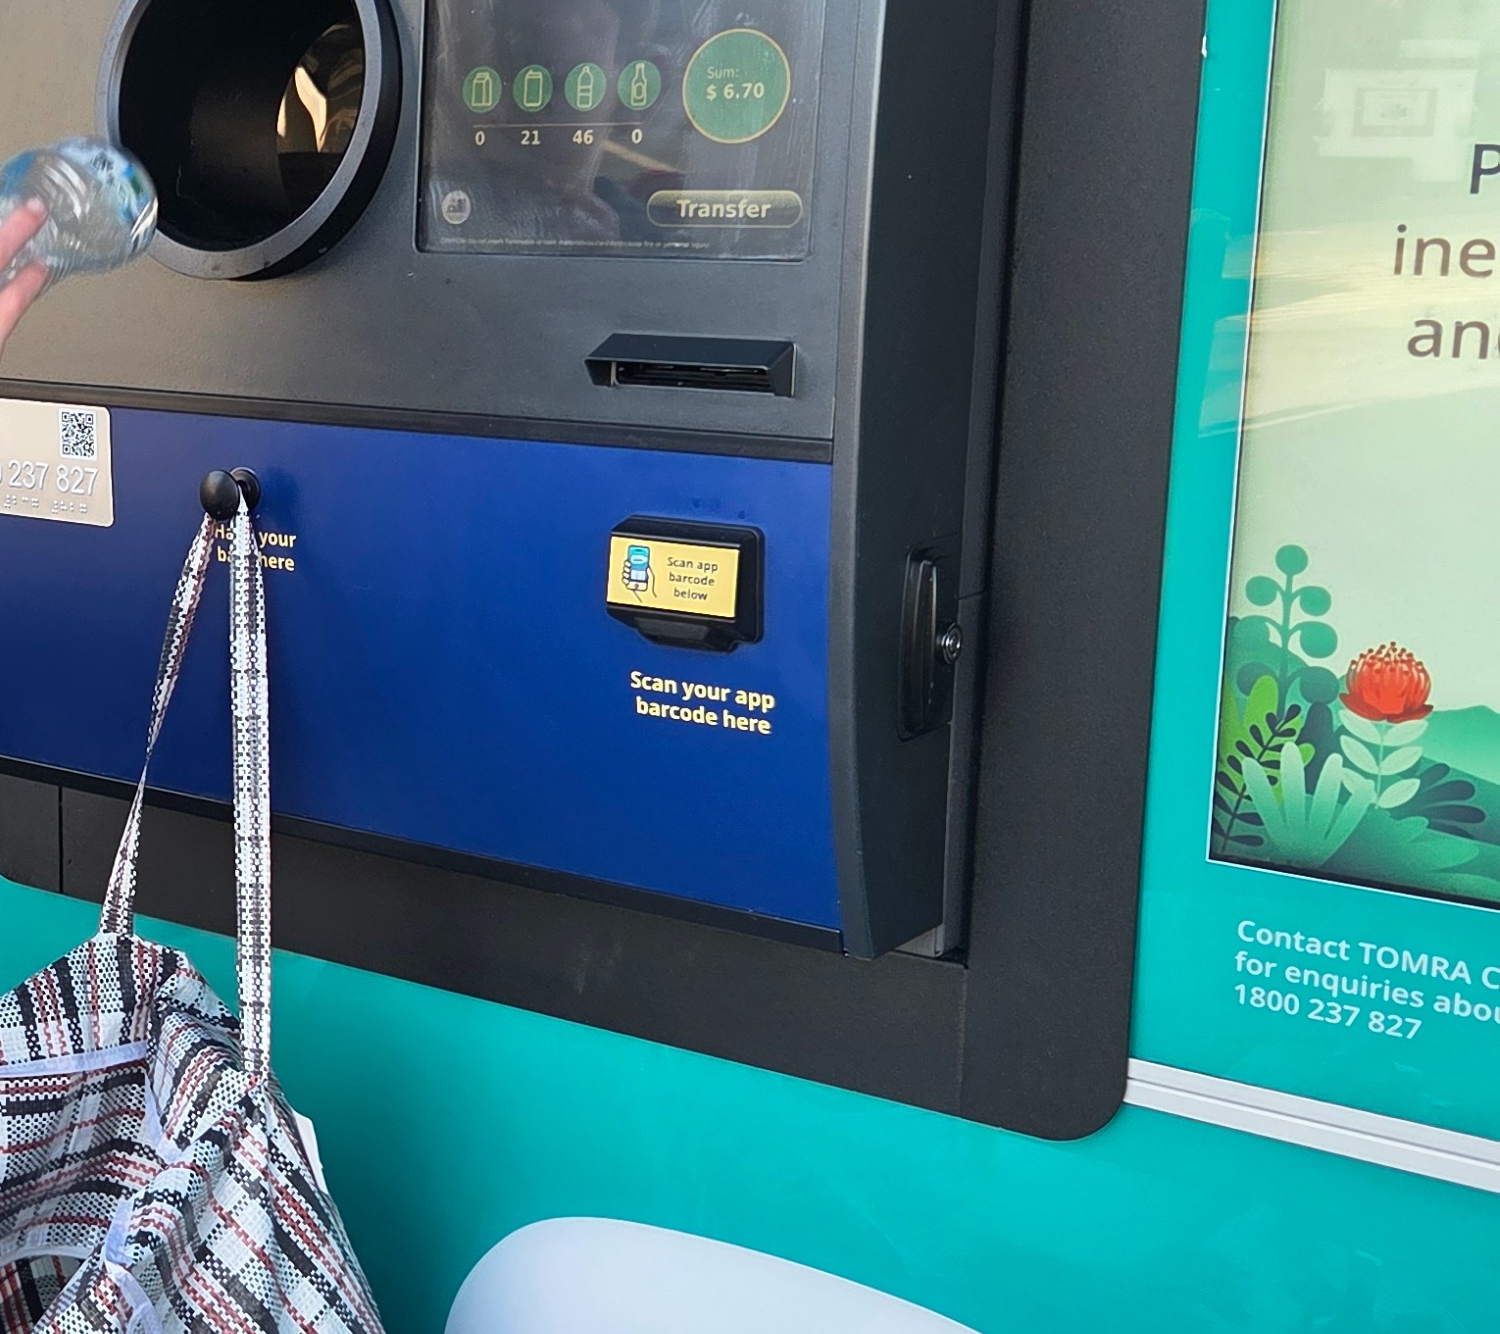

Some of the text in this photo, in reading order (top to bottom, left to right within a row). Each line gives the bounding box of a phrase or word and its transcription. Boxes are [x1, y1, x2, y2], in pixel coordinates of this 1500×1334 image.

[707, 66, 739, 79] Sum:
[706, 82, 765, 101] $ 6.70
[475, 128, 643, 146] 0 21 46 0
[676, 199, 772, 219] Transfer
[1408, 319, 1500, 360] an
[9, 459, 49, 489] 237
[56, 465, 98, 495] 827
[259, 531, 296, 548] your
[667, 557, 718, 573] Scan app
[669, 572, 715, 586] barcode
[674, 588, 708, 600] below
[631, 671, 775, 711] Scan your app
[636, 696, 772, 736] barcode here
[1237, 920, 1472, 985] Contact TOMRA
[1234, 950, 1424, 1008] for enquiries
[1234, 983, 1422, 1040] 1800 237 827
